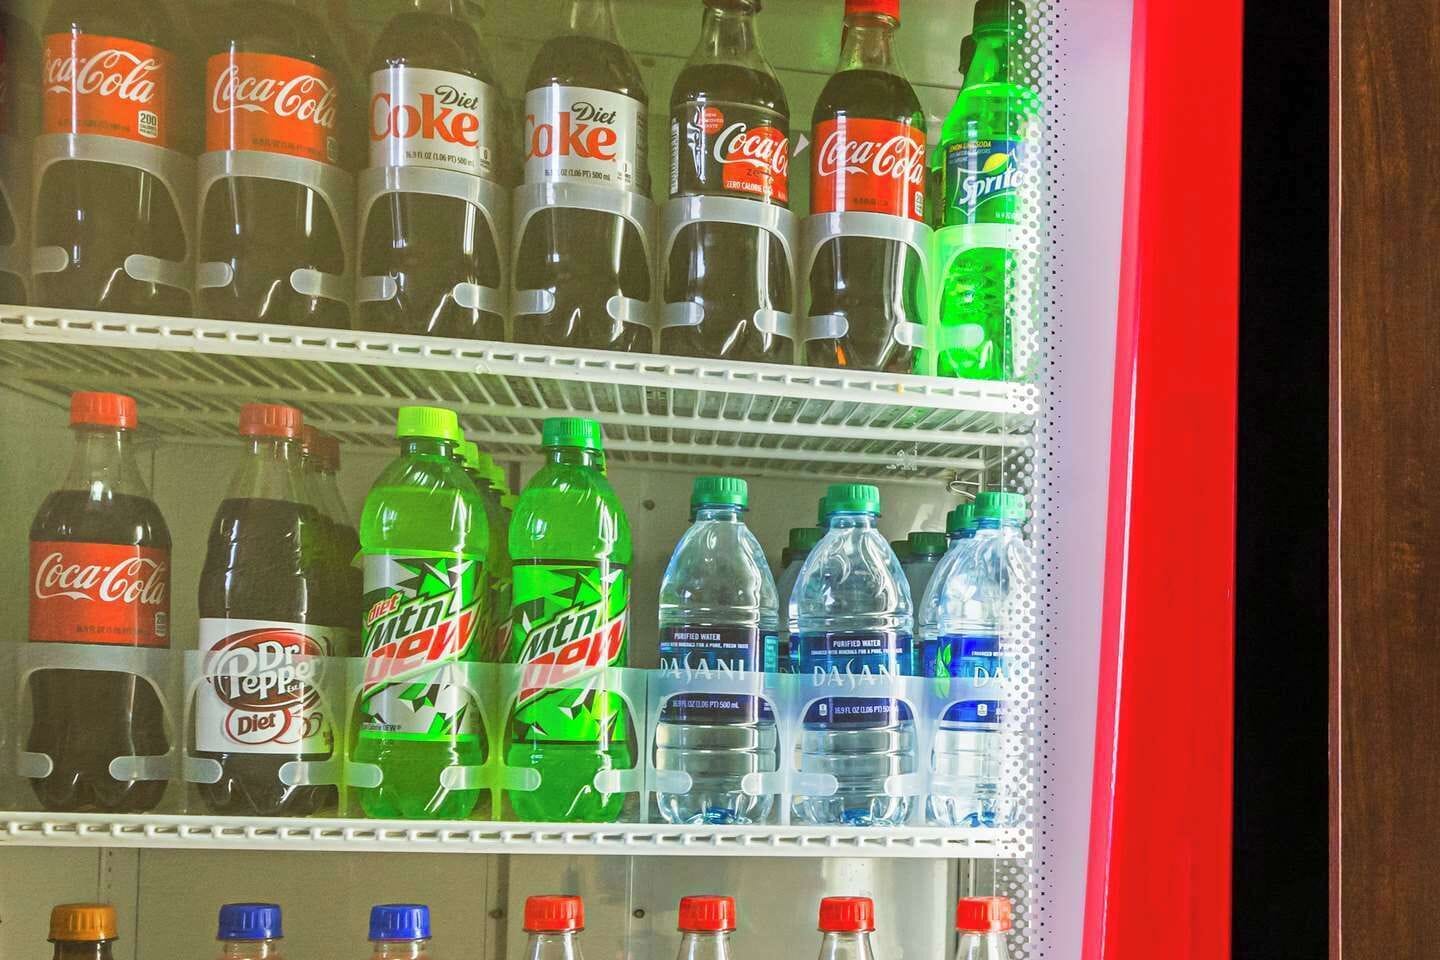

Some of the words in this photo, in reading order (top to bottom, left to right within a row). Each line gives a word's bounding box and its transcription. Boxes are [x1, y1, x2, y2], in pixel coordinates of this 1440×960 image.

[48, 49, 161, 103] ca-Cola
[213, 64, 336, 128] Coca-Cola
[435, 85, 478, 110] Diet
[572, 101, 616, 125] Diet
[140, 112, 157, 127] 200
[370, 92, 479, 147] Coke
[714, 122, 789, 177] Coca-Co
[817, 131, 925, 185] Coca-Cola
[958, 161, 1024, 206] Sprite
[35, 551, 166, 605] Coca-Cola
[367, 599, 445, 652] Mtn
[369, 593, 400, 620] diet
[257, 640, 300, 671] Dr
[520, 609, 600, 663] Mtn
[673, 632, 699, 641] PURIFIED
[699, 633, 721, 641] WATER
[832, 640, 861, 648] PURIFIED
[862, 639, 881, 647] WATER
[216, 646, 321, 700] Pepper
[660, 650, 745, 684] DASANI
[813, 657, 901, 692] DASANI
[237, 713, 276, 736] Diet
